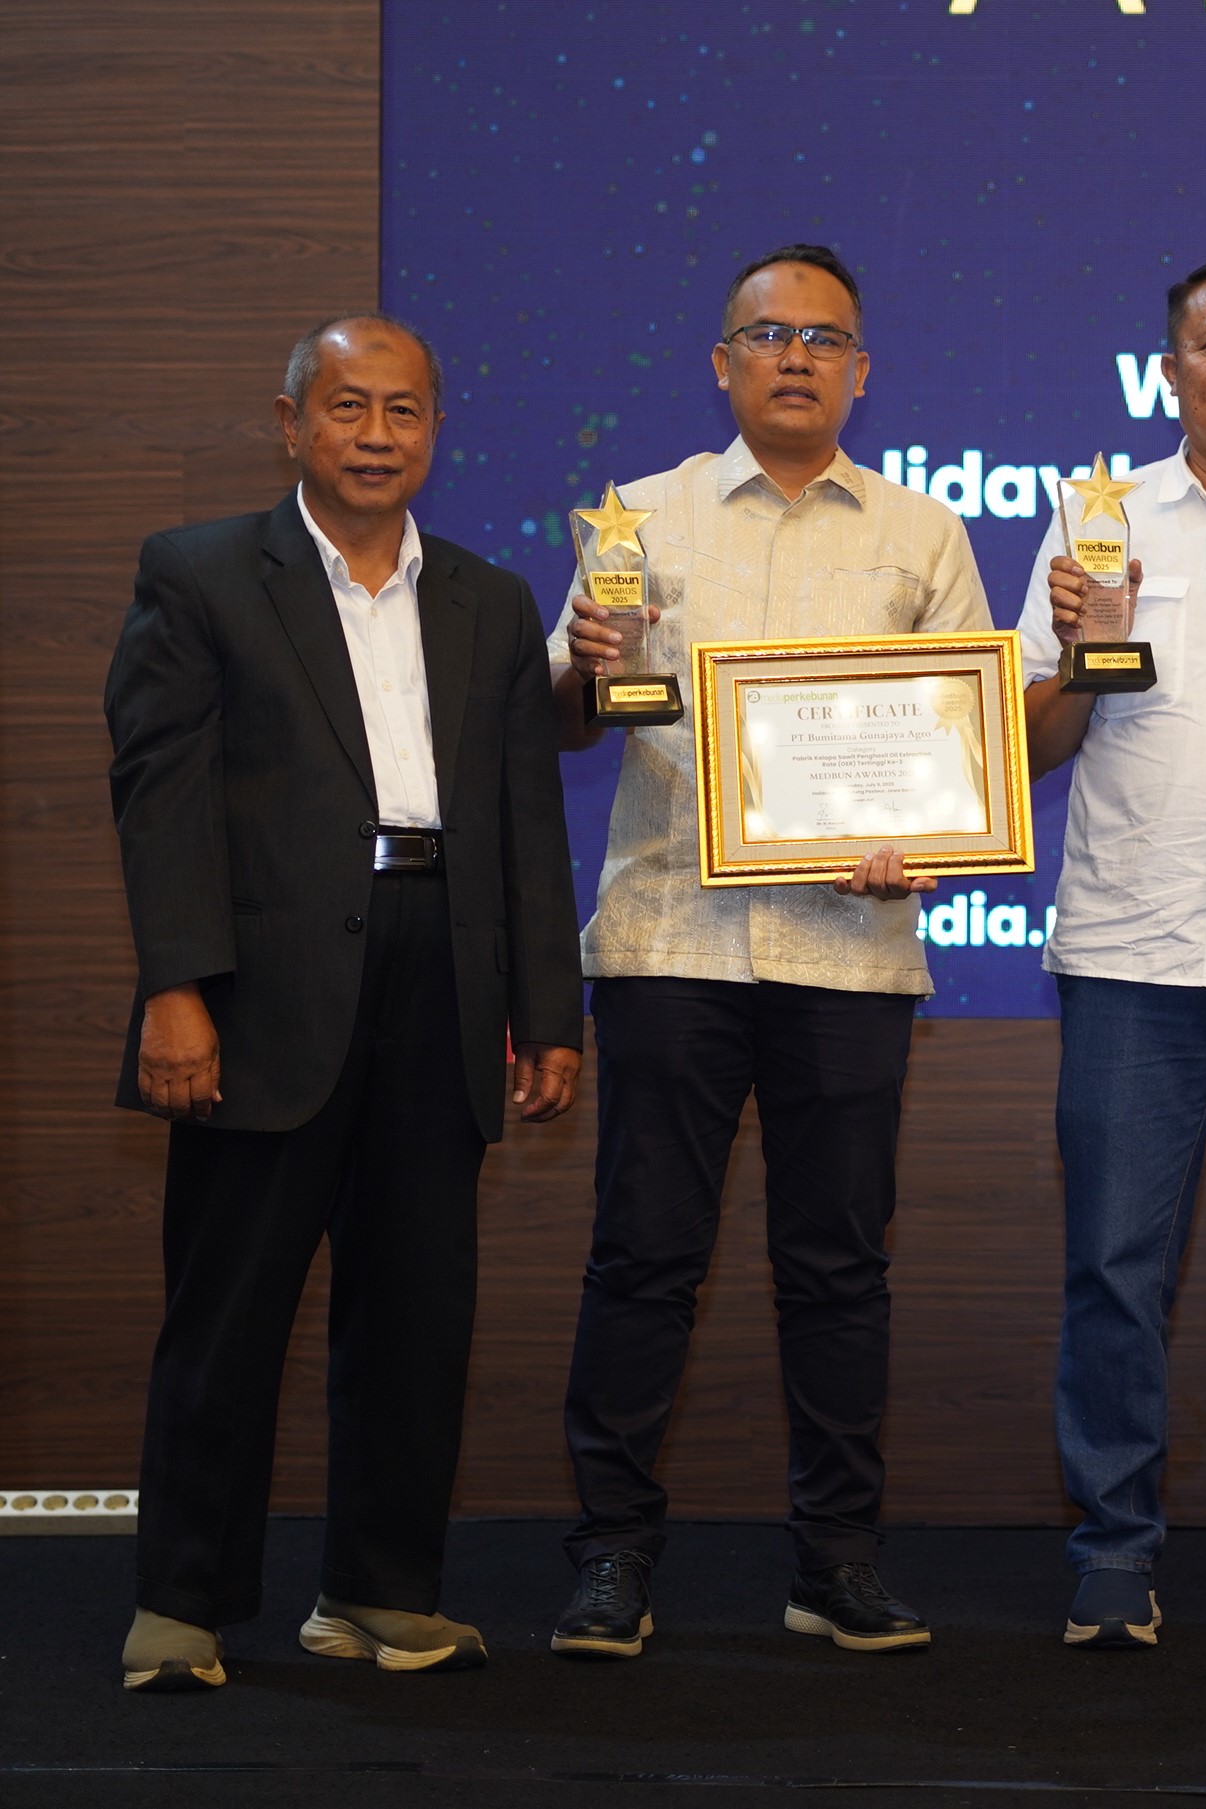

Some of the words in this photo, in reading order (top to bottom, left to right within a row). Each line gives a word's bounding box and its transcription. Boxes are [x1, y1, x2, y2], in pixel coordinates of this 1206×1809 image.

[1077, 543, 1121, 553] medbun
[1083, 555, 1119, 563] AWARDS
[594, 574, 639, 585] medbun
[601, 587, 637, 595] AWARDS
[797, 703, 923, 721] CERFICATE
[791, 733, 805, 743] PT
[808, 731, 857, 743] Bumitama
[859, 730, 905, 743] Gunajaya
[907, 729, 931, 741] Agro
[847, 746, 876, 754] Category
[814, 754, 837, 762] Kelapa
[857, 752, 888, 760] Penghasil
[857, 759, 886, 767] Tertinggi
[810, 771, 852, 781] MEDBUN
[854, 770, 897, 779] AWARDS
